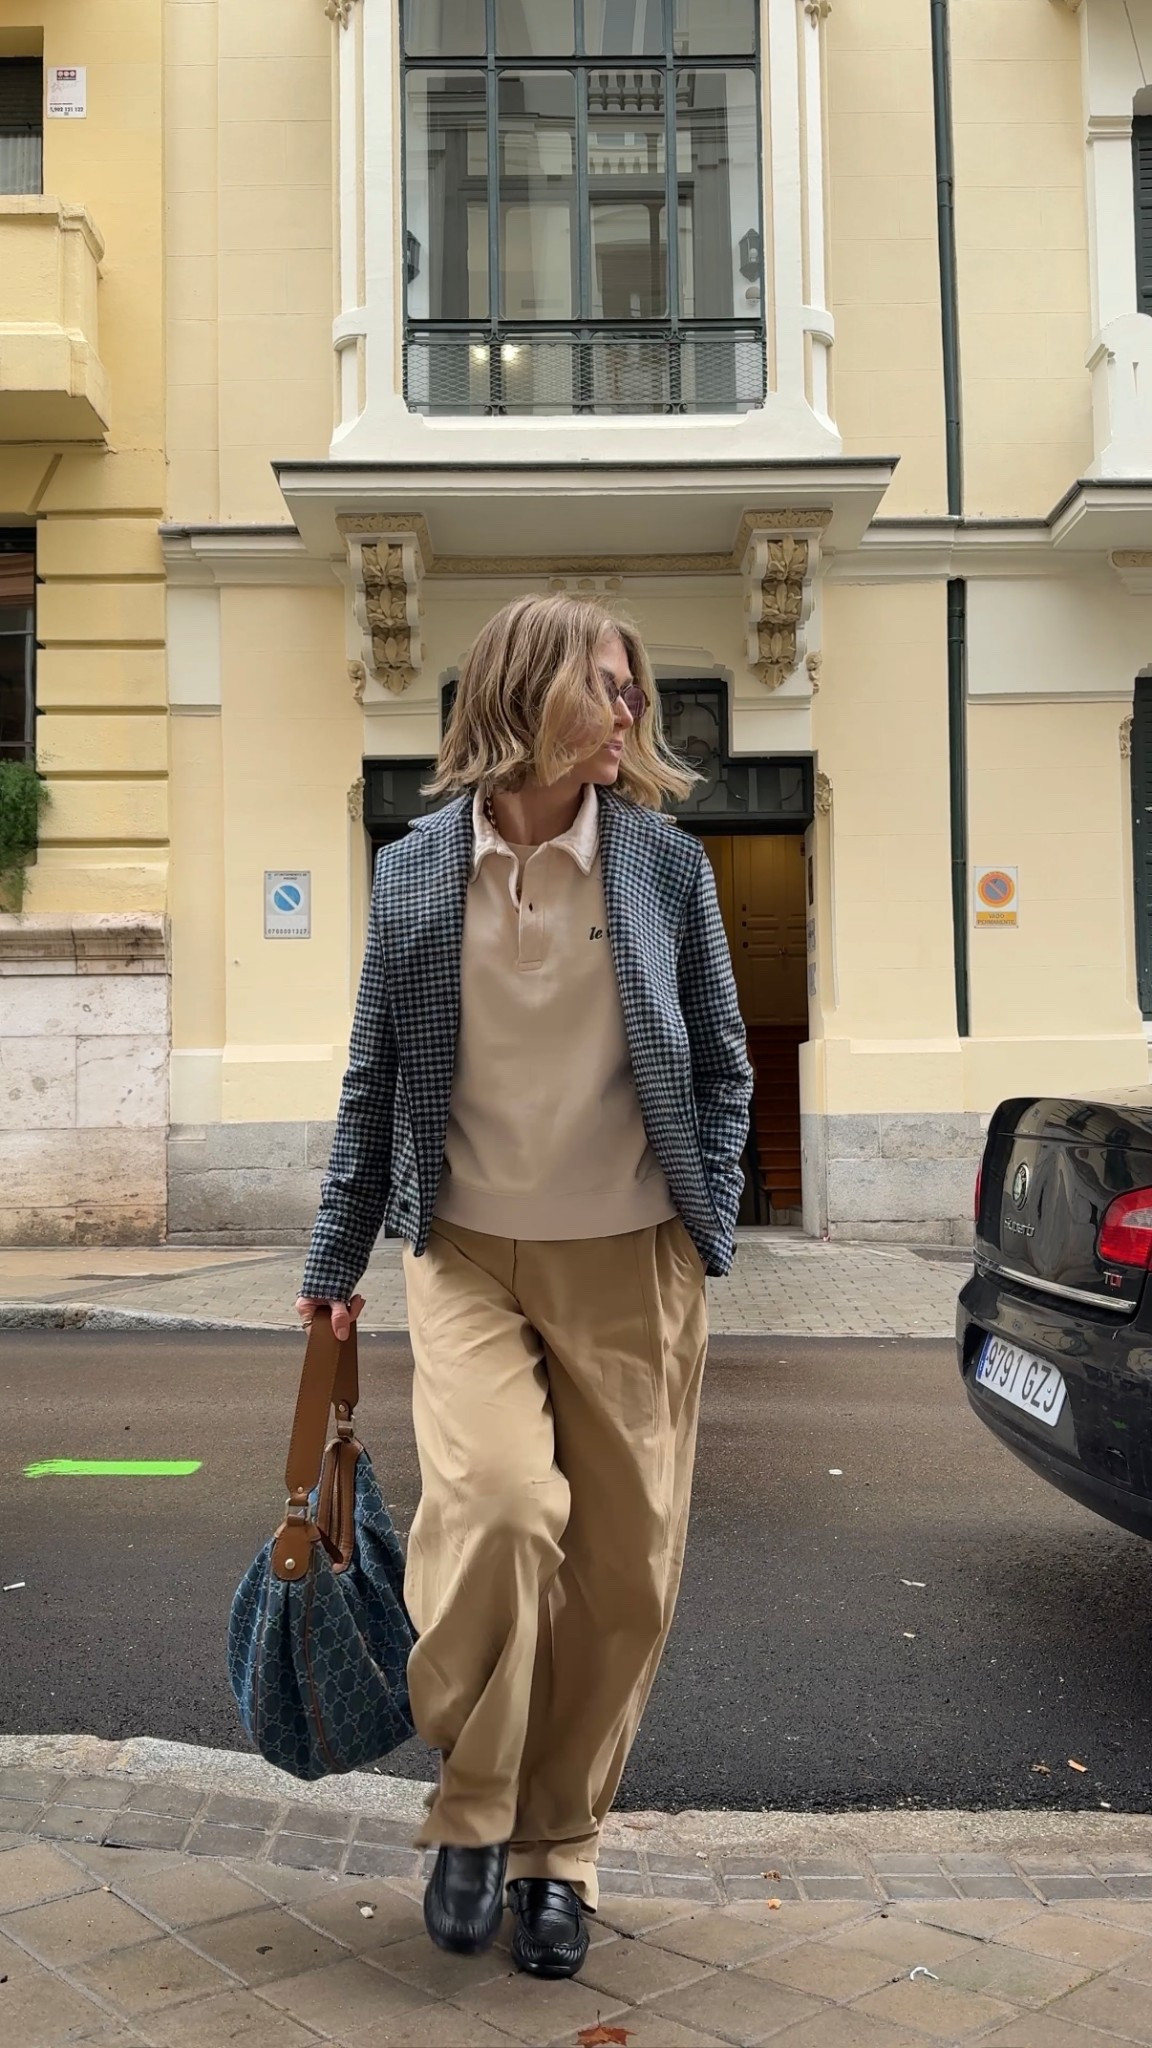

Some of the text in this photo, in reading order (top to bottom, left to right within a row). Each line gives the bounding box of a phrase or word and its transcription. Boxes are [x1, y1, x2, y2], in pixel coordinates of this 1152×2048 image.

[589, 926, 603, 940] le
[985, 1341, 1062, 1413] 9791 GZJ
